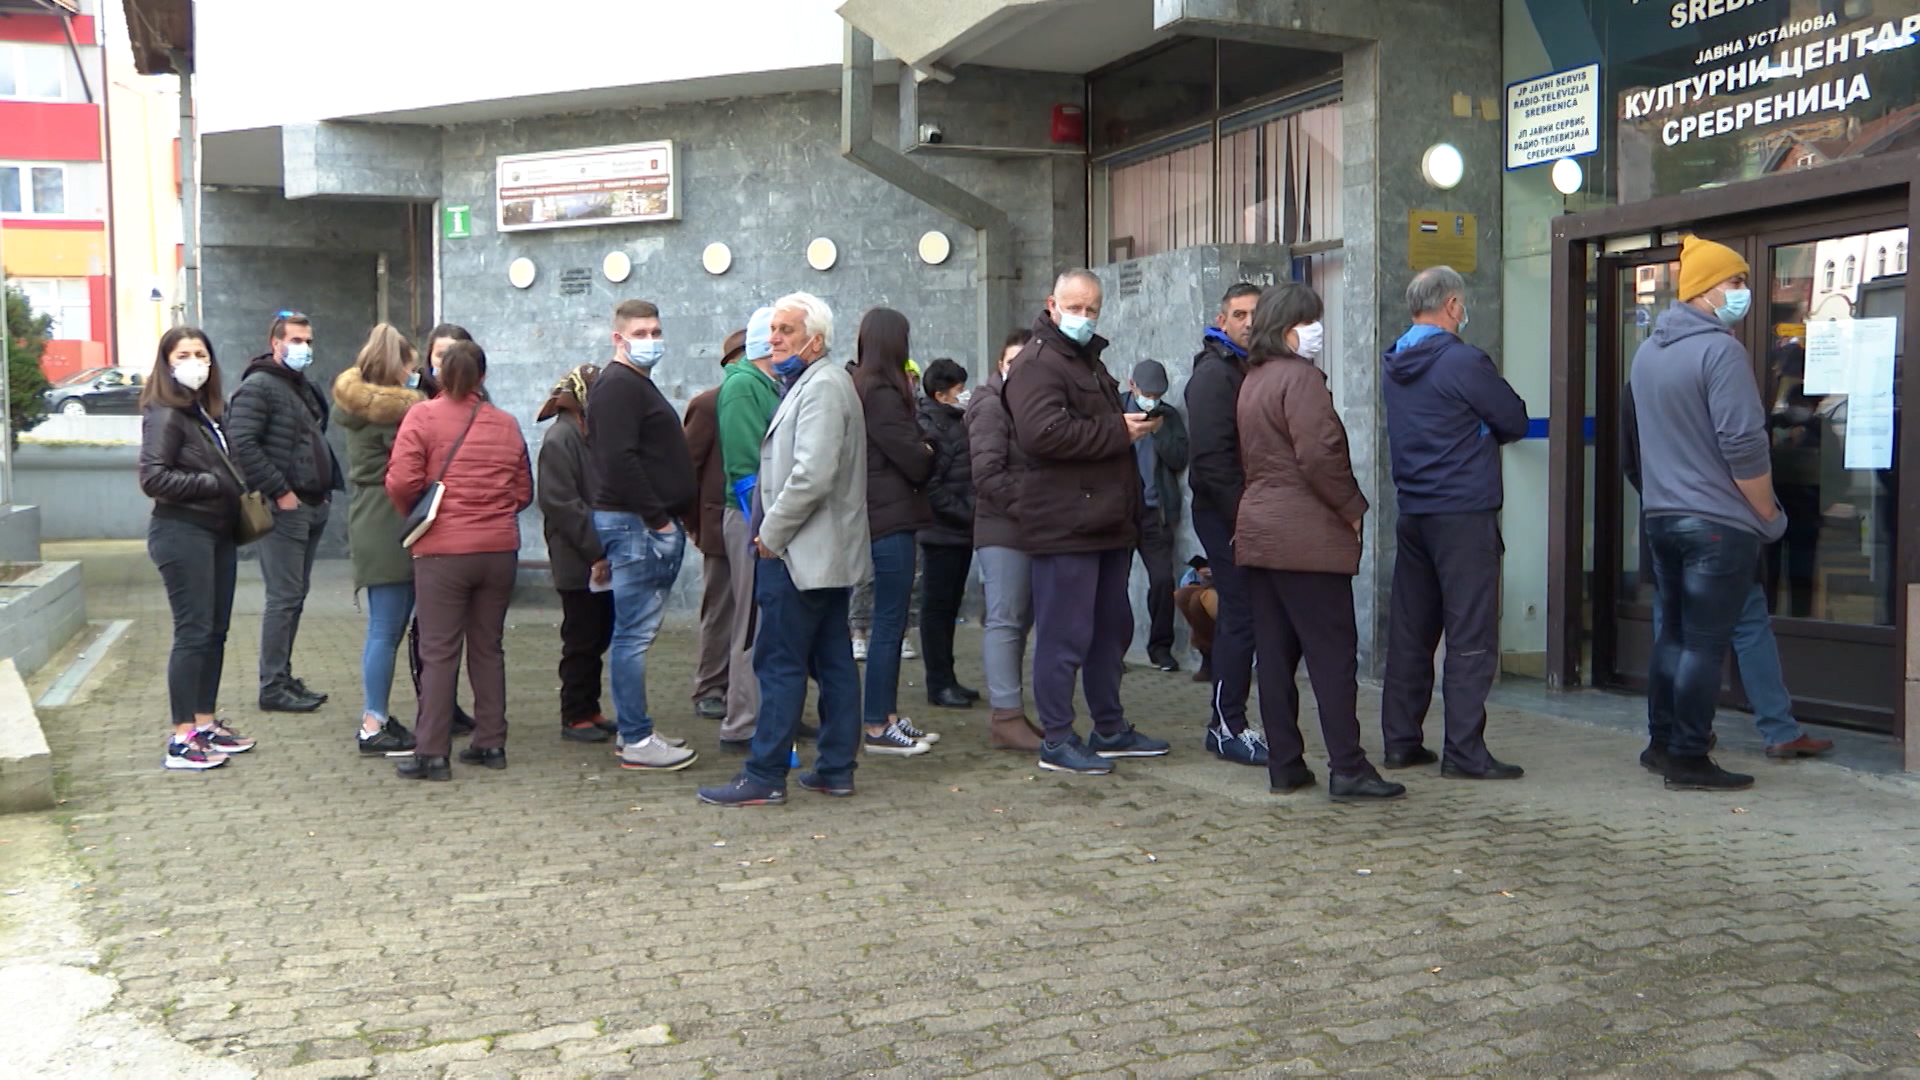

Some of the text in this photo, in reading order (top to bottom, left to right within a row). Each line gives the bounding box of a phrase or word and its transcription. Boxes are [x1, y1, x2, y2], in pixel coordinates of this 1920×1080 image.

[1695, 12, 1837, 65] ЈАВНА УСТАНОВА
[1624, 13, 1920, 119] КУЛТУРНИ ЦЕНТАР
[1517, 71, 1587, 97] JP JAVNI SERVIS
[1525, 98, 1578, 118] SREBRENICA
[1662, 73, 1871, 146] СРЕБРЕНИЦА
[1529, 123, 1554, 137] ЈАВНИ
[1555, 115, 1586, 131] СЕРВИС
[1526, 143, 1576, 160] СРЕБРЕНИЦА
